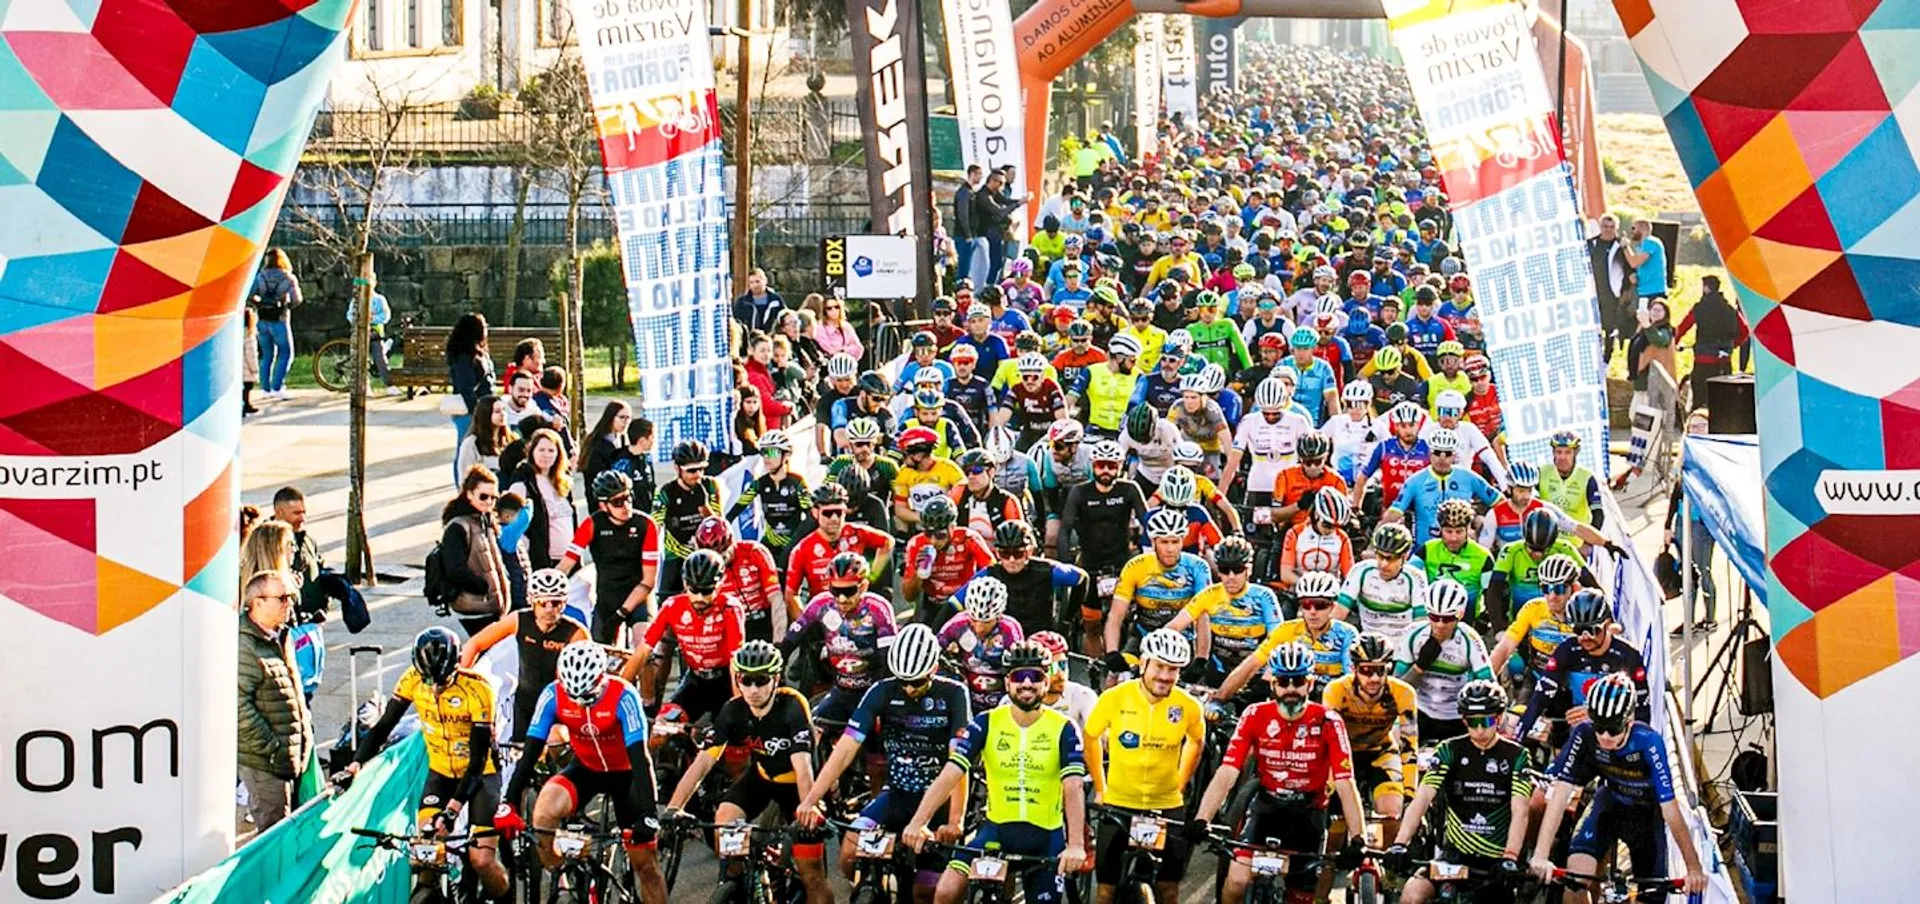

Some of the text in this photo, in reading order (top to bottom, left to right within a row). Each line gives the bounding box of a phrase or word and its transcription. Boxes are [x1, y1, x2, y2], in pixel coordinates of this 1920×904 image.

[1037, 42, 1056, 62] AO
[1206, 33, 1229, 95] auto
[825, 238, 844, 275] BOX
[1824, 480, 1920, 501] www.
[1563, 734, 1582, 775] PROTEU
[1650, 746, 1670, 789] PROTEU
